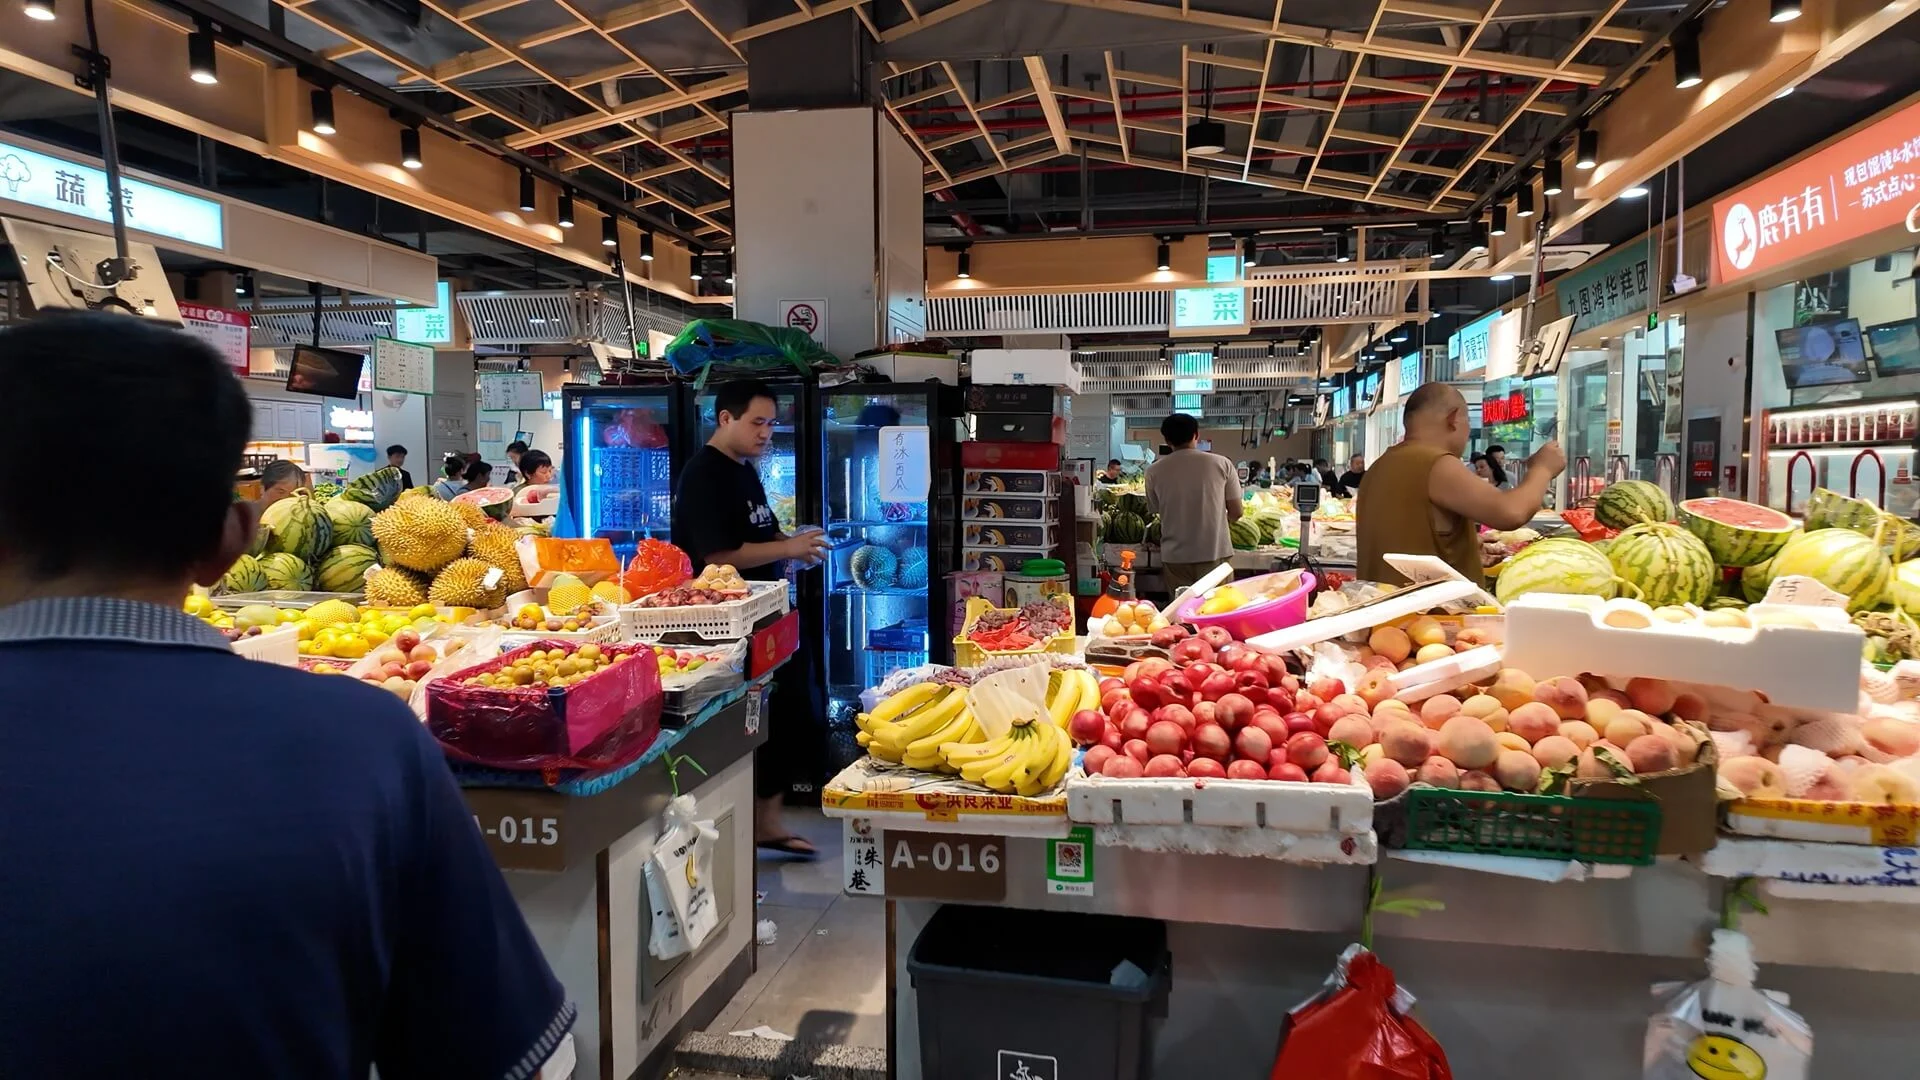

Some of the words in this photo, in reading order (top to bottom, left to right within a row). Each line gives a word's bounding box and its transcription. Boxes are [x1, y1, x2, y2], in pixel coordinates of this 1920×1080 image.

[1757, 185, 1825, 249] 鹿有有
[1213, 292, 1238, 320] 菜
[425, 314, 445, 338] 菜
[889, 432, 910, 493] 有冰西瓜
[473, 815, 559, 846] -015
[891, 839, 1000, 873] A-016
